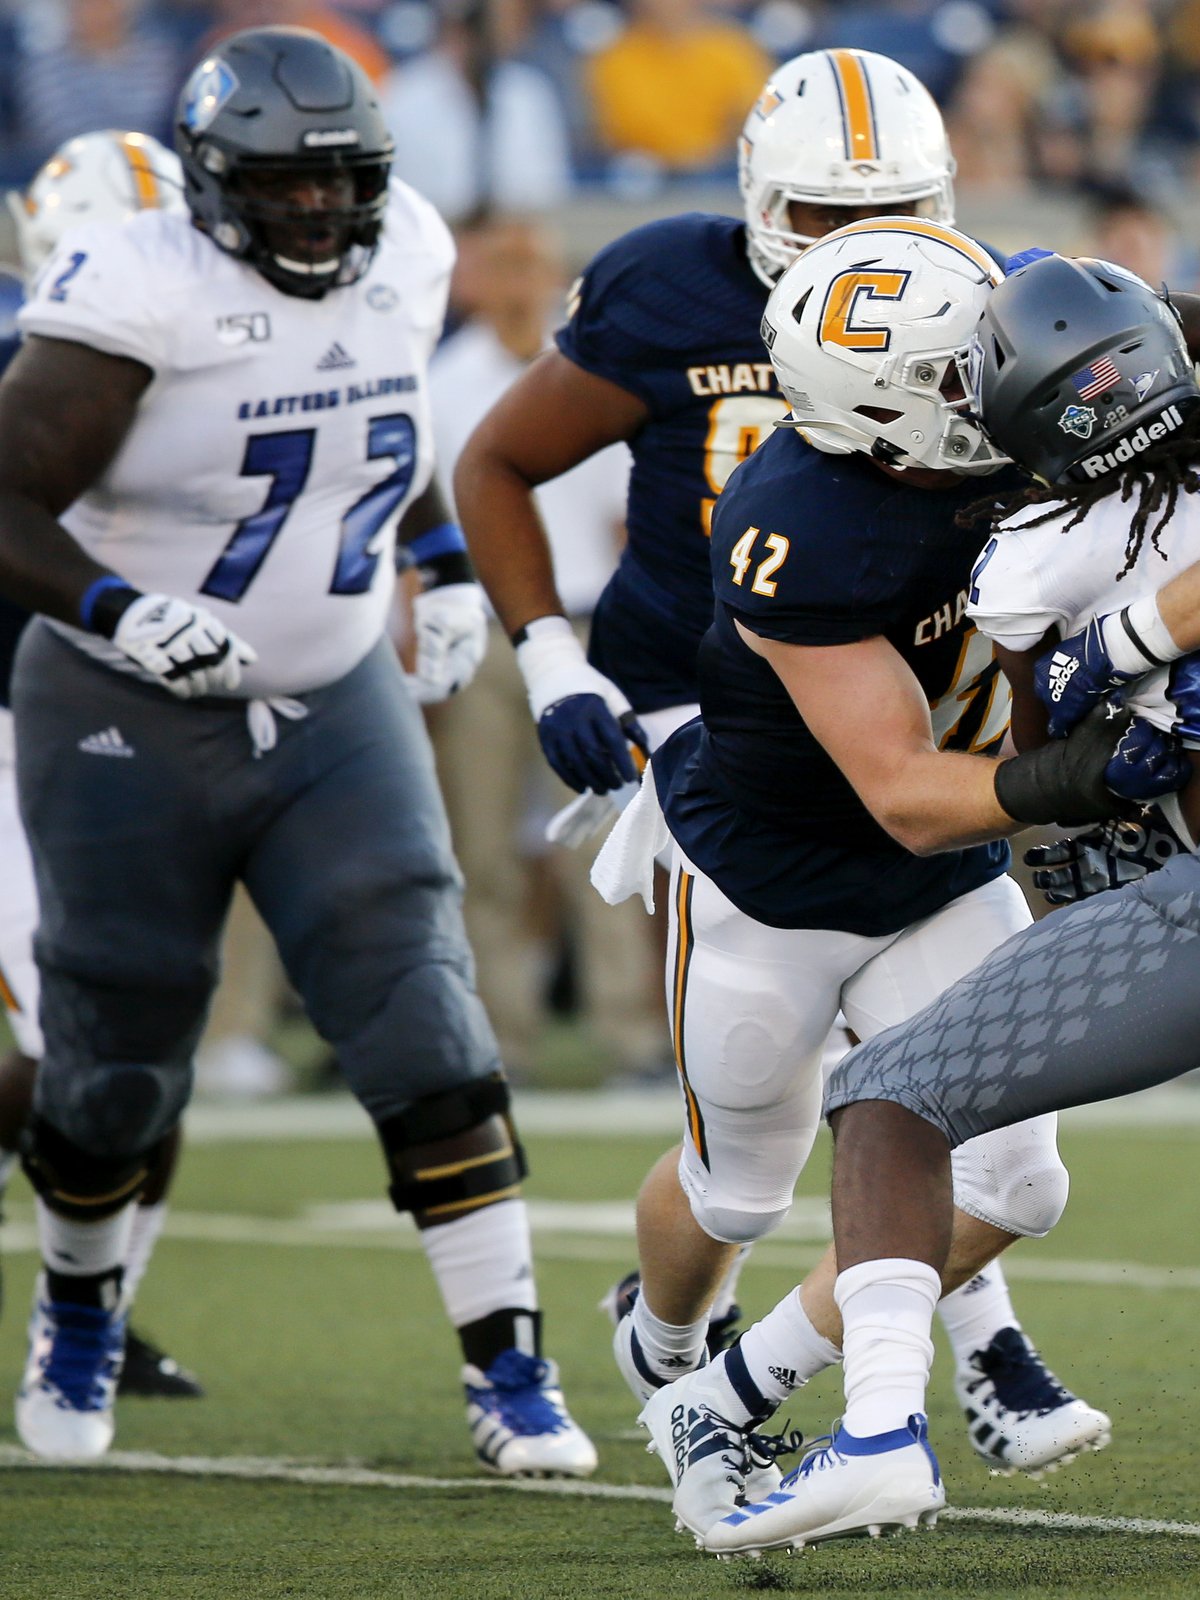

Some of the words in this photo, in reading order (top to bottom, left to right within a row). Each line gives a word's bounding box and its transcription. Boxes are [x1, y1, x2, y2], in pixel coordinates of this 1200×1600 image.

[817, 267, 912, 352] C
[682, 363, 775, 397] CHAT
[1081, 405, 1184, 479] Riddell
[1106, 405, 1130, 428] 22
[701, 396, 794, 538] 9
[198, 413, 416, 604] 72
[729, 526, 790, 597] 42
[914, 589, 970, 646] CHA
[1051, 656, 1081, 702] adidas
[671, 1404, 689, 1488] adida
